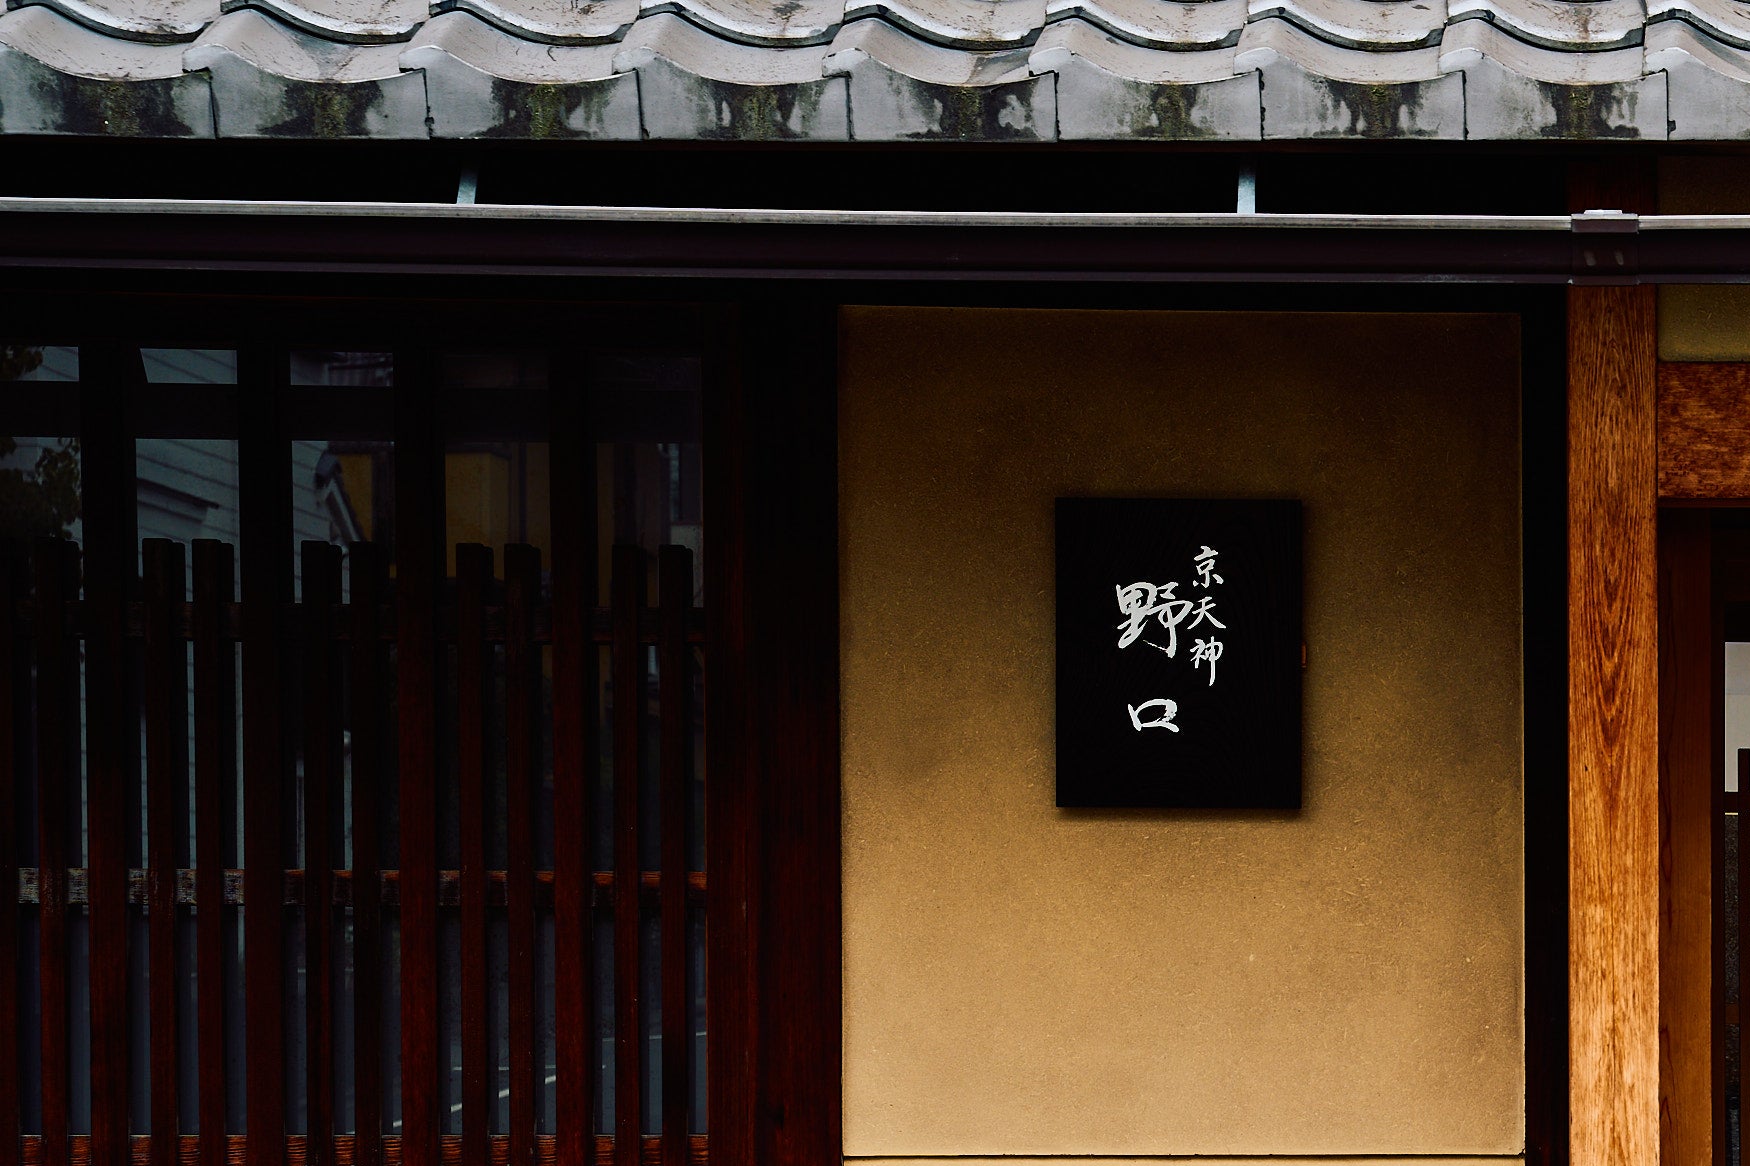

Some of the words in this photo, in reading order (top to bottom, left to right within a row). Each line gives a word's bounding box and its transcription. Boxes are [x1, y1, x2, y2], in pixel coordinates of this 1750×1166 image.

[1115, 581, 1194, 733] 野口
[1187, 545, 1227, 687] 京天神
